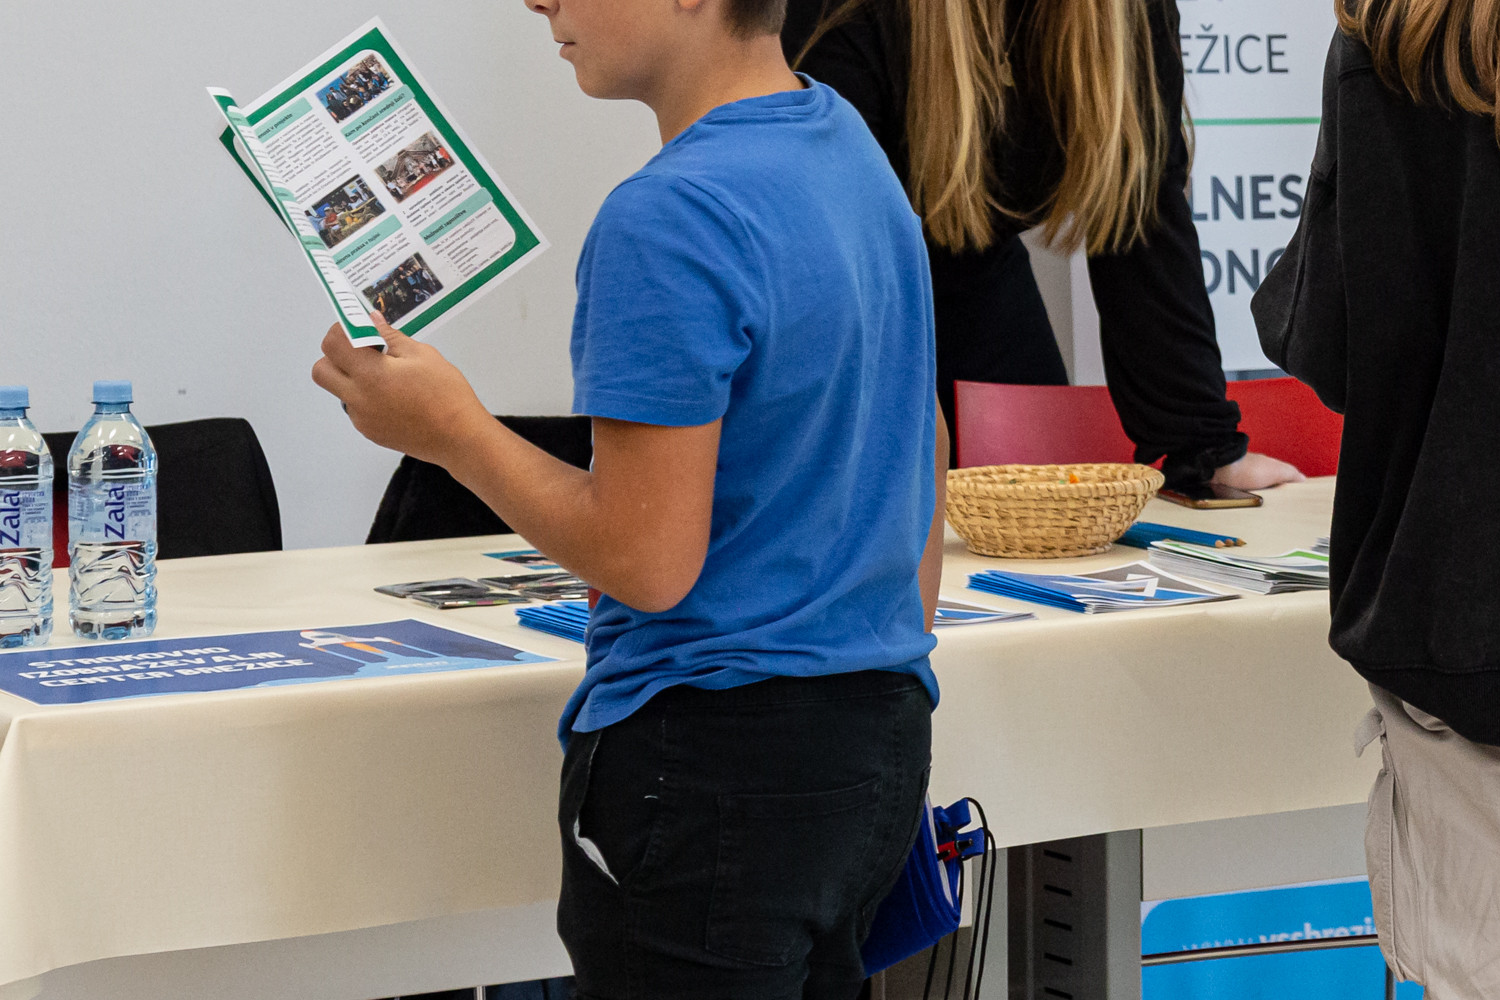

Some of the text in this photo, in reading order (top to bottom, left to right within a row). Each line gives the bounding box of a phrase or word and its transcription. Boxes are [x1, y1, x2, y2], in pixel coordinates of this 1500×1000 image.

[1180, 23, 1289, 74] EŽICE
[0, 491, 20, 547] Zala
[104, 485, 125, 540] Zala
[27, 646, 231, 669] STROKOVNO
[39, 670, 175, 688] CENTER
